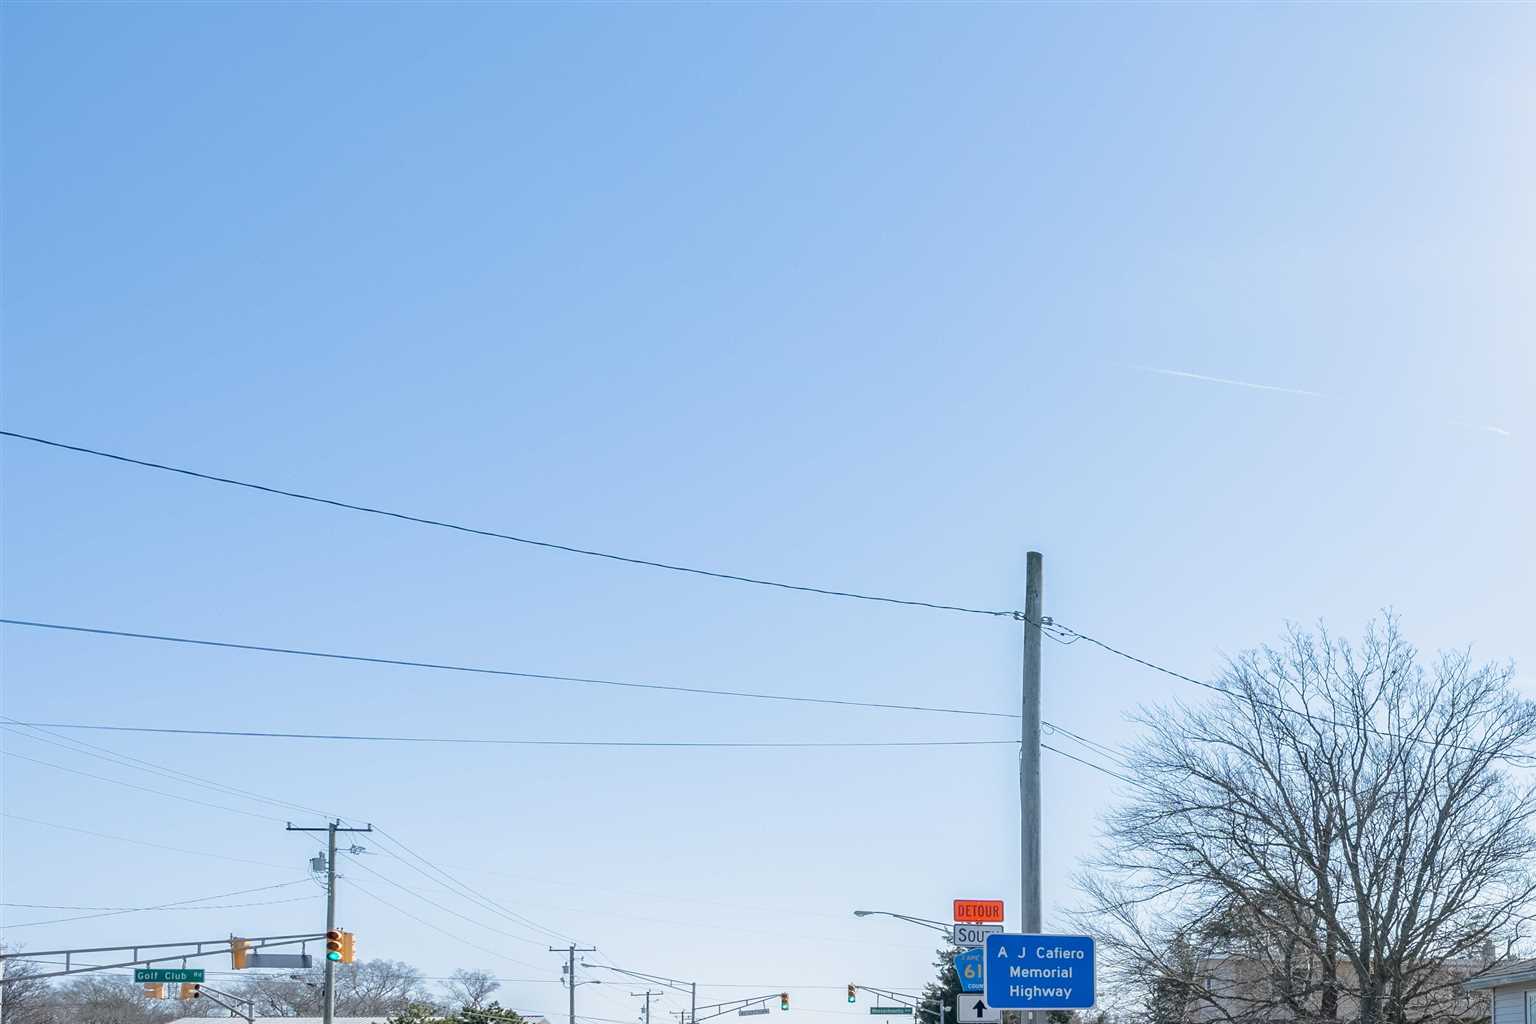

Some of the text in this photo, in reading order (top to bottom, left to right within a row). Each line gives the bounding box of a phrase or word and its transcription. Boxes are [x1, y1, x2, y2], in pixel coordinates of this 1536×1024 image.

[958, 905, 999, 917] DETOUR
[958, 928, 993, 943] SOU
[997, 946, 1008, 958] A
[1017, 946, 1026, 959] J
[1036, 946, 1084, 959] Cafiero
[137, 971, 158, 980] Golf
[165, 971, 187, 980] Club
[1010, 966, 1072, 978] Memorial
[1010, 985, 1072, 1000] Highway
